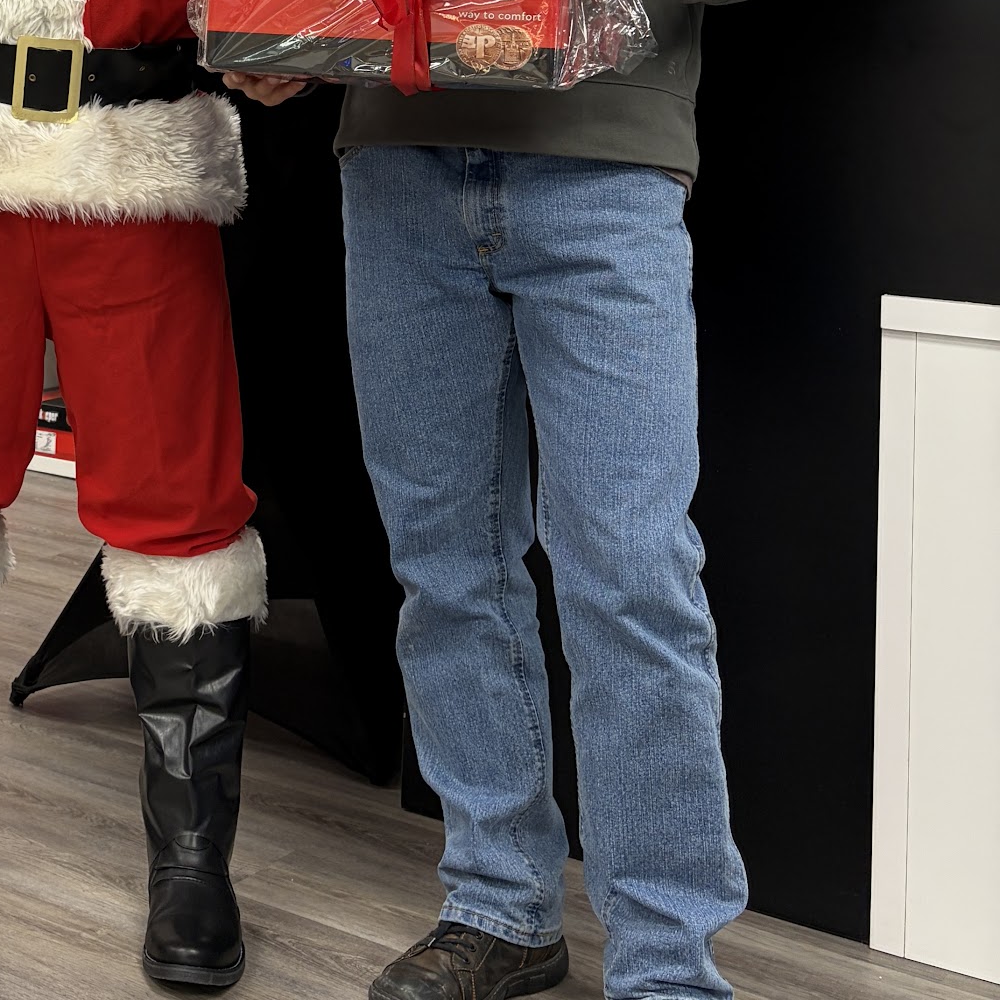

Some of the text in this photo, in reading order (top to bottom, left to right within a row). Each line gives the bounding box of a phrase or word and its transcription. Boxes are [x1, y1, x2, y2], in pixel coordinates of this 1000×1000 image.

[458, 11, 481, 21] way
[483, 11, 495, 20] to
[498, 11, 542, 22] comfort
